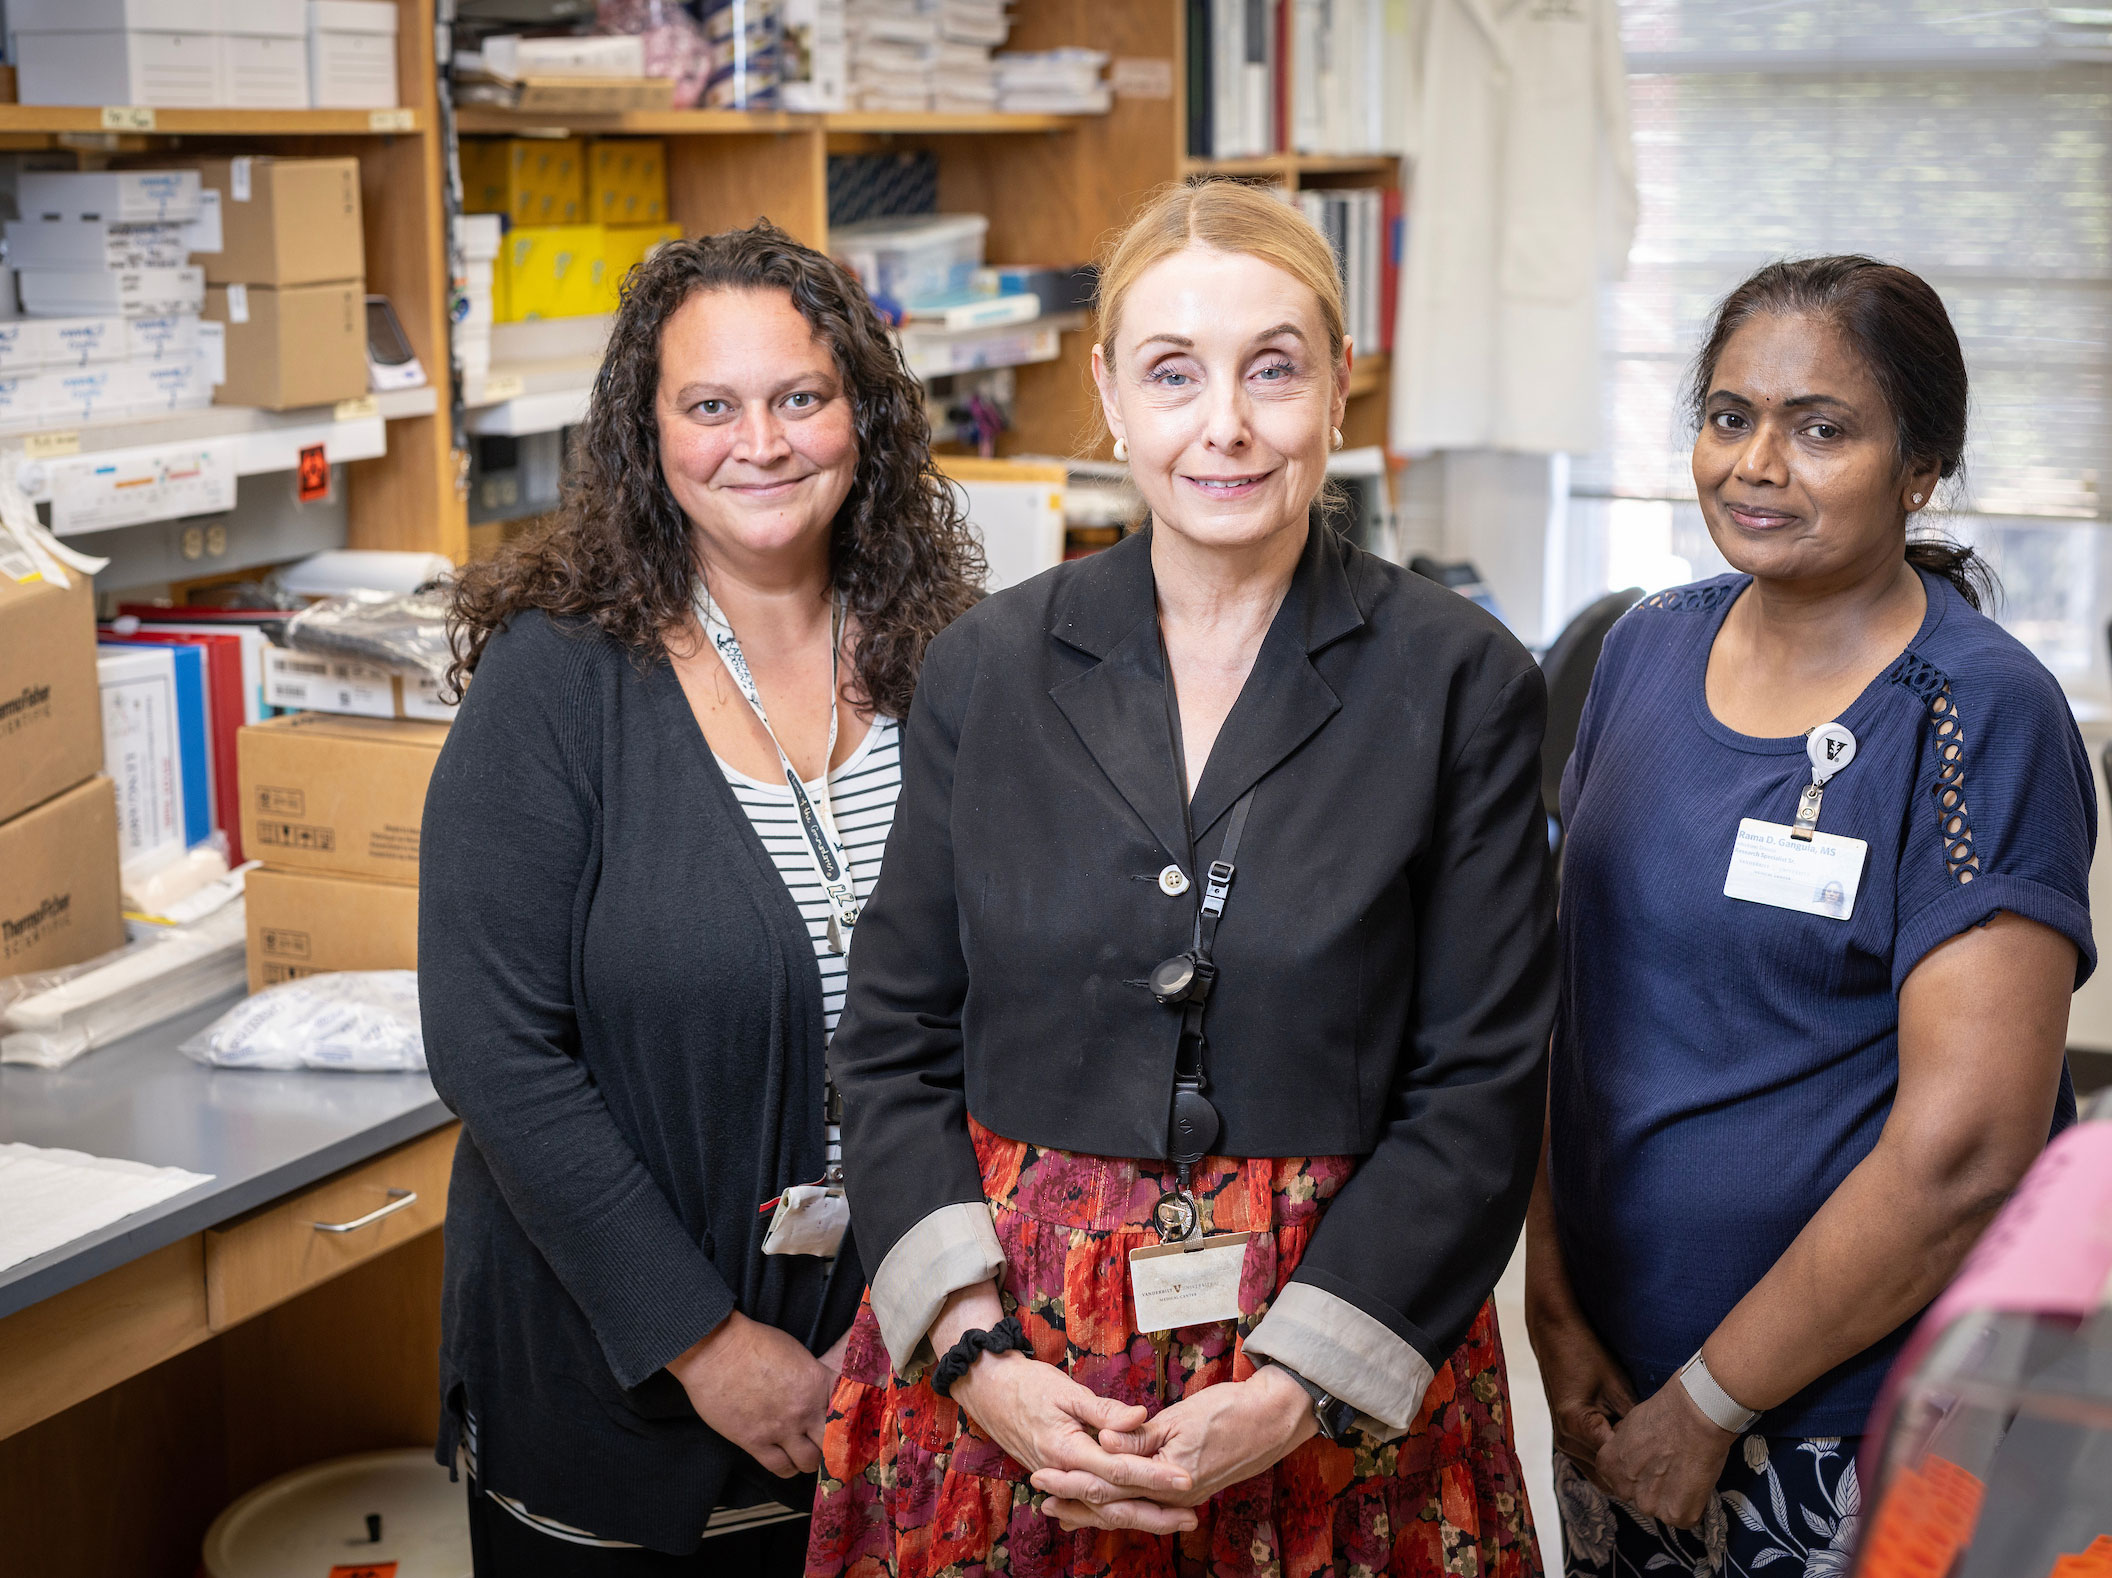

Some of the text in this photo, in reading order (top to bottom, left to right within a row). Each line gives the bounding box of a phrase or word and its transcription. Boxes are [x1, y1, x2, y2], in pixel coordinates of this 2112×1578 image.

[1825, 737, 1848, 760] V
[1739, 830, 1764, 844] Rama
[1766, 836, 1776, 845] D.
[1778, 838, 1818, 855] Gangula,
[1820, 846, 1836, 857] MS
[1142, 1288, 1173, 1297] VANDERBILT
